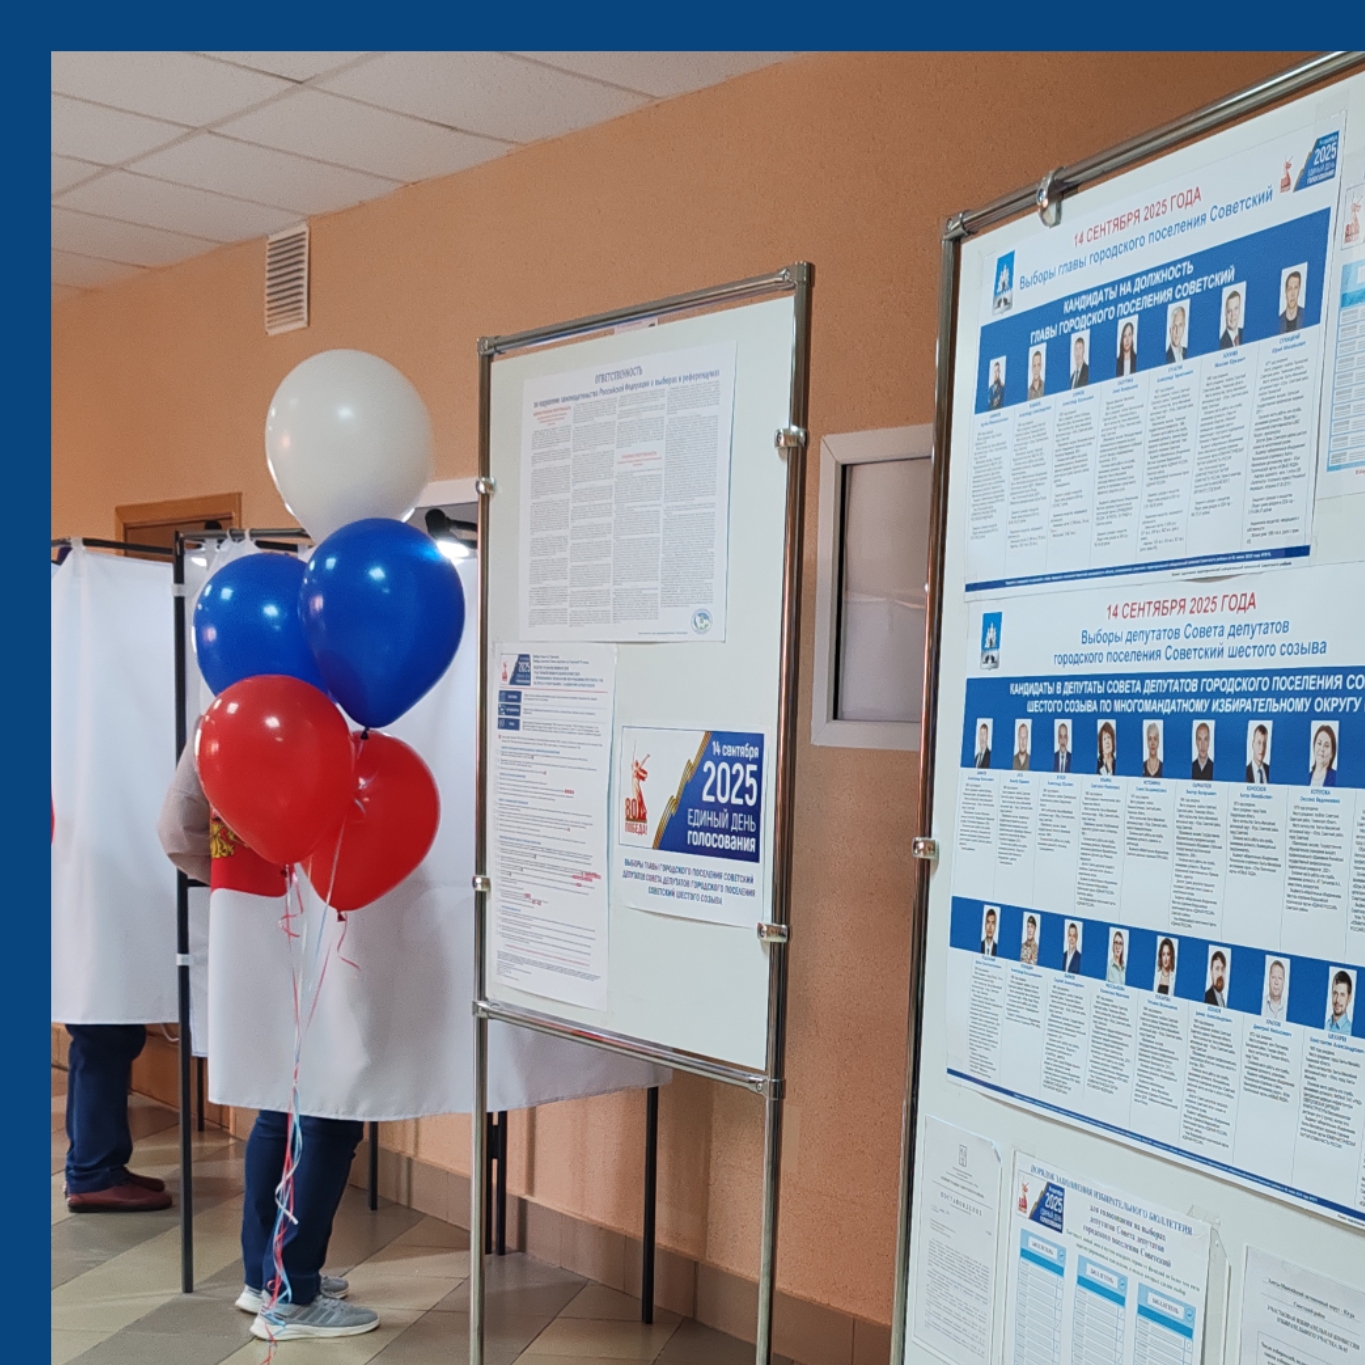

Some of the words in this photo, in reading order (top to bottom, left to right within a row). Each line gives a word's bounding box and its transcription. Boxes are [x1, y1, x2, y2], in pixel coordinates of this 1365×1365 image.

[1314, 142, 1337, 165] 2025
[1074, 229, 1083, 248] 14
[1086, 208, 1140, 243] СЕНТЯБРЯ
[1143, 197, 1167, 222] 2025
[1170, 184, 1202, 214] ГОДА
[1019, 266, 1055, 291] Выборы
[1058, 255, 1086, 277] главы
[1089, 234, 1144, 267] городского
[1149, 211, 1206, 244] поселения
[1210, 185, 1273, 221] Советский
[1063, 284, 1117, 315] КАНДИДАТЫ
[1120, 279, 1131, 296] НА
[1133, 259, 1193, 293] ДОЛЖНОСТЬ
[1030, 324, 1056, 344] ГЛАВЫ
[1059, 305, 1114, 336] ГОРОДСКОГО
[1117, 287, 1172, 317] ПОСЕЛЕНИЯ
[1174, 264, 1235, 299] СОВЕТСКИЙ
[1106, 604, 1118, 619] 14
[1121, 598, 1186, 618] СЕНТЯБРЯ
[1188, 595, 1217, 614] 2025
[1220, 592, 1256, 614] ГОДА
[1081, 628, 1122, 647] Выборы
[1125, 626, 1180, 646] депутатов
[1184, 621, 1224, 638] Совета
[1226, 620, 1289, 640] депутатов
[1054, 651, 1103, 667] городского
[1106, 648, 1161, 662] поселения
[1165, 643, 1224, 660] Советский
[1228, 643, 1275, 658] шестого
[1280, 641, 1326, 656] созыва
[1010, 682, 1052, 696] КАНДИДАТЫ
[1063, 681, 1104, 695] ДЕПУТАТЫ
[1107, 680, 1141, 694] СОВЕТА
[1143, 678, 1198, 694] ДЕПУТАТОВ
[1200, 676, 1268, 693] ГОРОДСКОГО
[1271, 674, 1342, 691] ПОСЕЛЕНИЯ
[1026, 701, 1062, 712] ШЕСТОГО
[1064, 700, 1098, 712] СОЗЫВА
[1100, 700, 1111, 712] ПО
[1113, 699, 1209, 714] МНОГОМАНДАТНОМУ
[1211, 698, 1310, 712] ИЗБИРАТЕЛЬНОМУ
[1314, 697, 1361, 712] ОКРУГУ
[712, 740, 720, 756] 14
[722, 743, 759, 760] сентября
[702, 761, 758, 806] 2025
[625, 798, 639, 819] 80
[687, 808, 729, 830] ЕДИНЫЙ
[730, 813, 756, 832] ДЕНЬ
[687, 830, 756, 853] голосования
[1045, 1192, 1062, 1214] 2025
